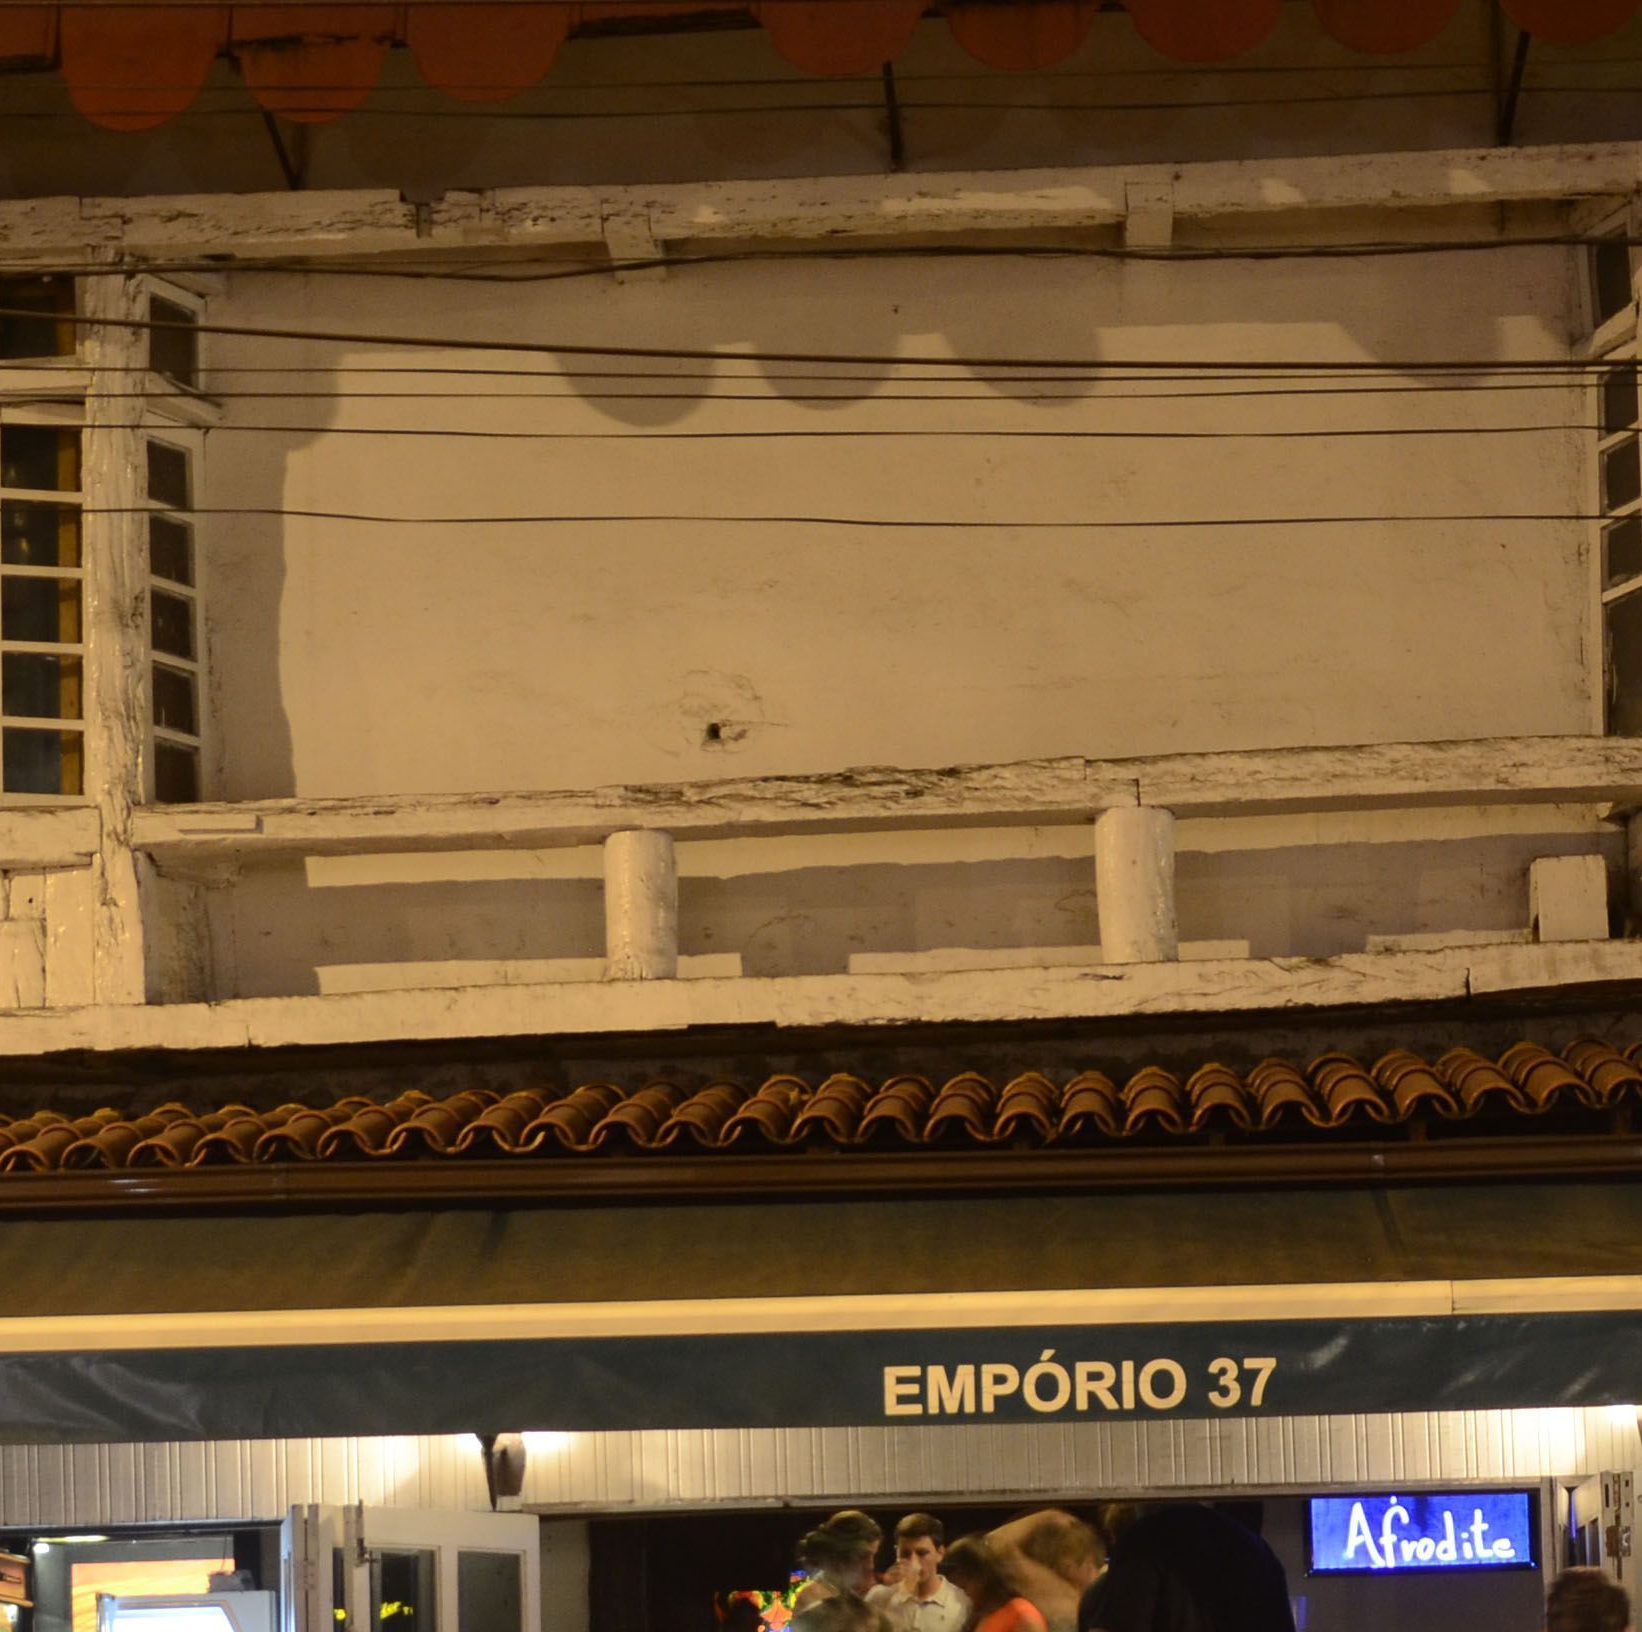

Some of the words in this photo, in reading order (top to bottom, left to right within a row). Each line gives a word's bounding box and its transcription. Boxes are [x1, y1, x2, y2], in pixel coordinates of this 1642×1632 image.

[883, 1349, 1187, 1416] EMPÓRIO
[1208, 1357, 1277, 1408] 37
[1343, 1498, 1515, 1568] Afrodite
